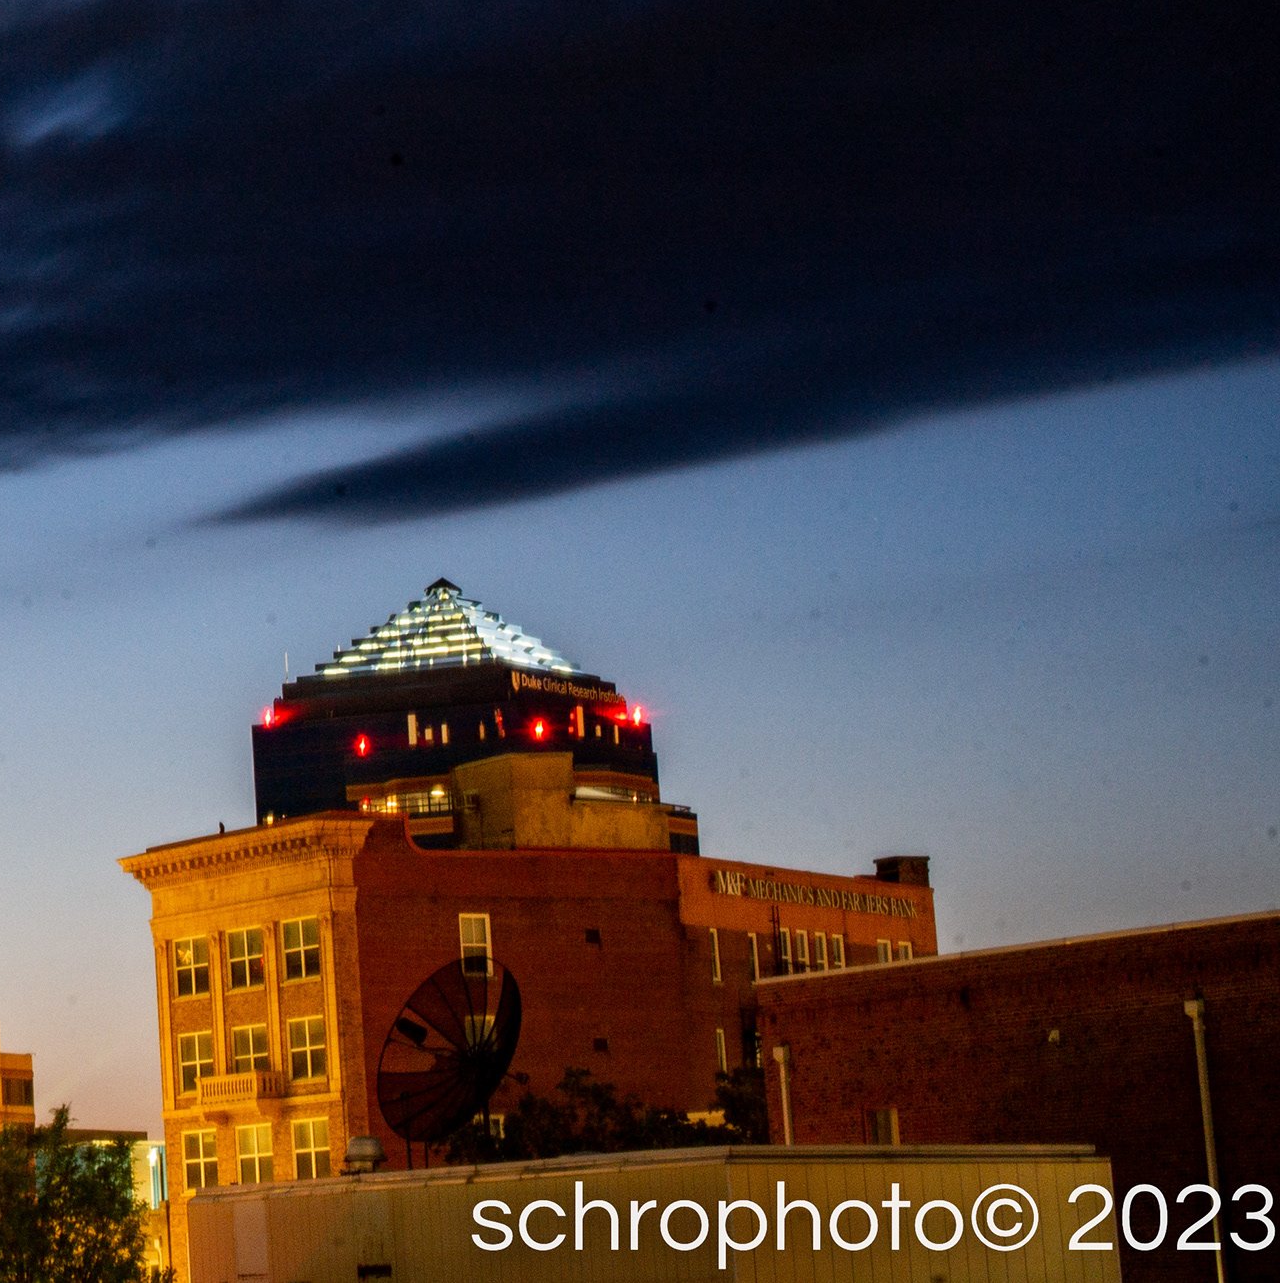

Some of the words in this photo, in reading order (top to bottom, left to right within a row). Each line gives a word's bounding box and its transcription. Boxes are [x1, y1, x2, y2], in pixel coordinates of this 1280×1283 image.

[521, 673, 542, 690] Duke
[543, 678, 567, 695] Clinical
[568, 682, 598, 701] Research
[716, 869, 746, 896] M&F
[748, 878, 815, 907] MECHANICS
[815, 887, 840, 909] AND
[890, 897, 918, 919] BANK
